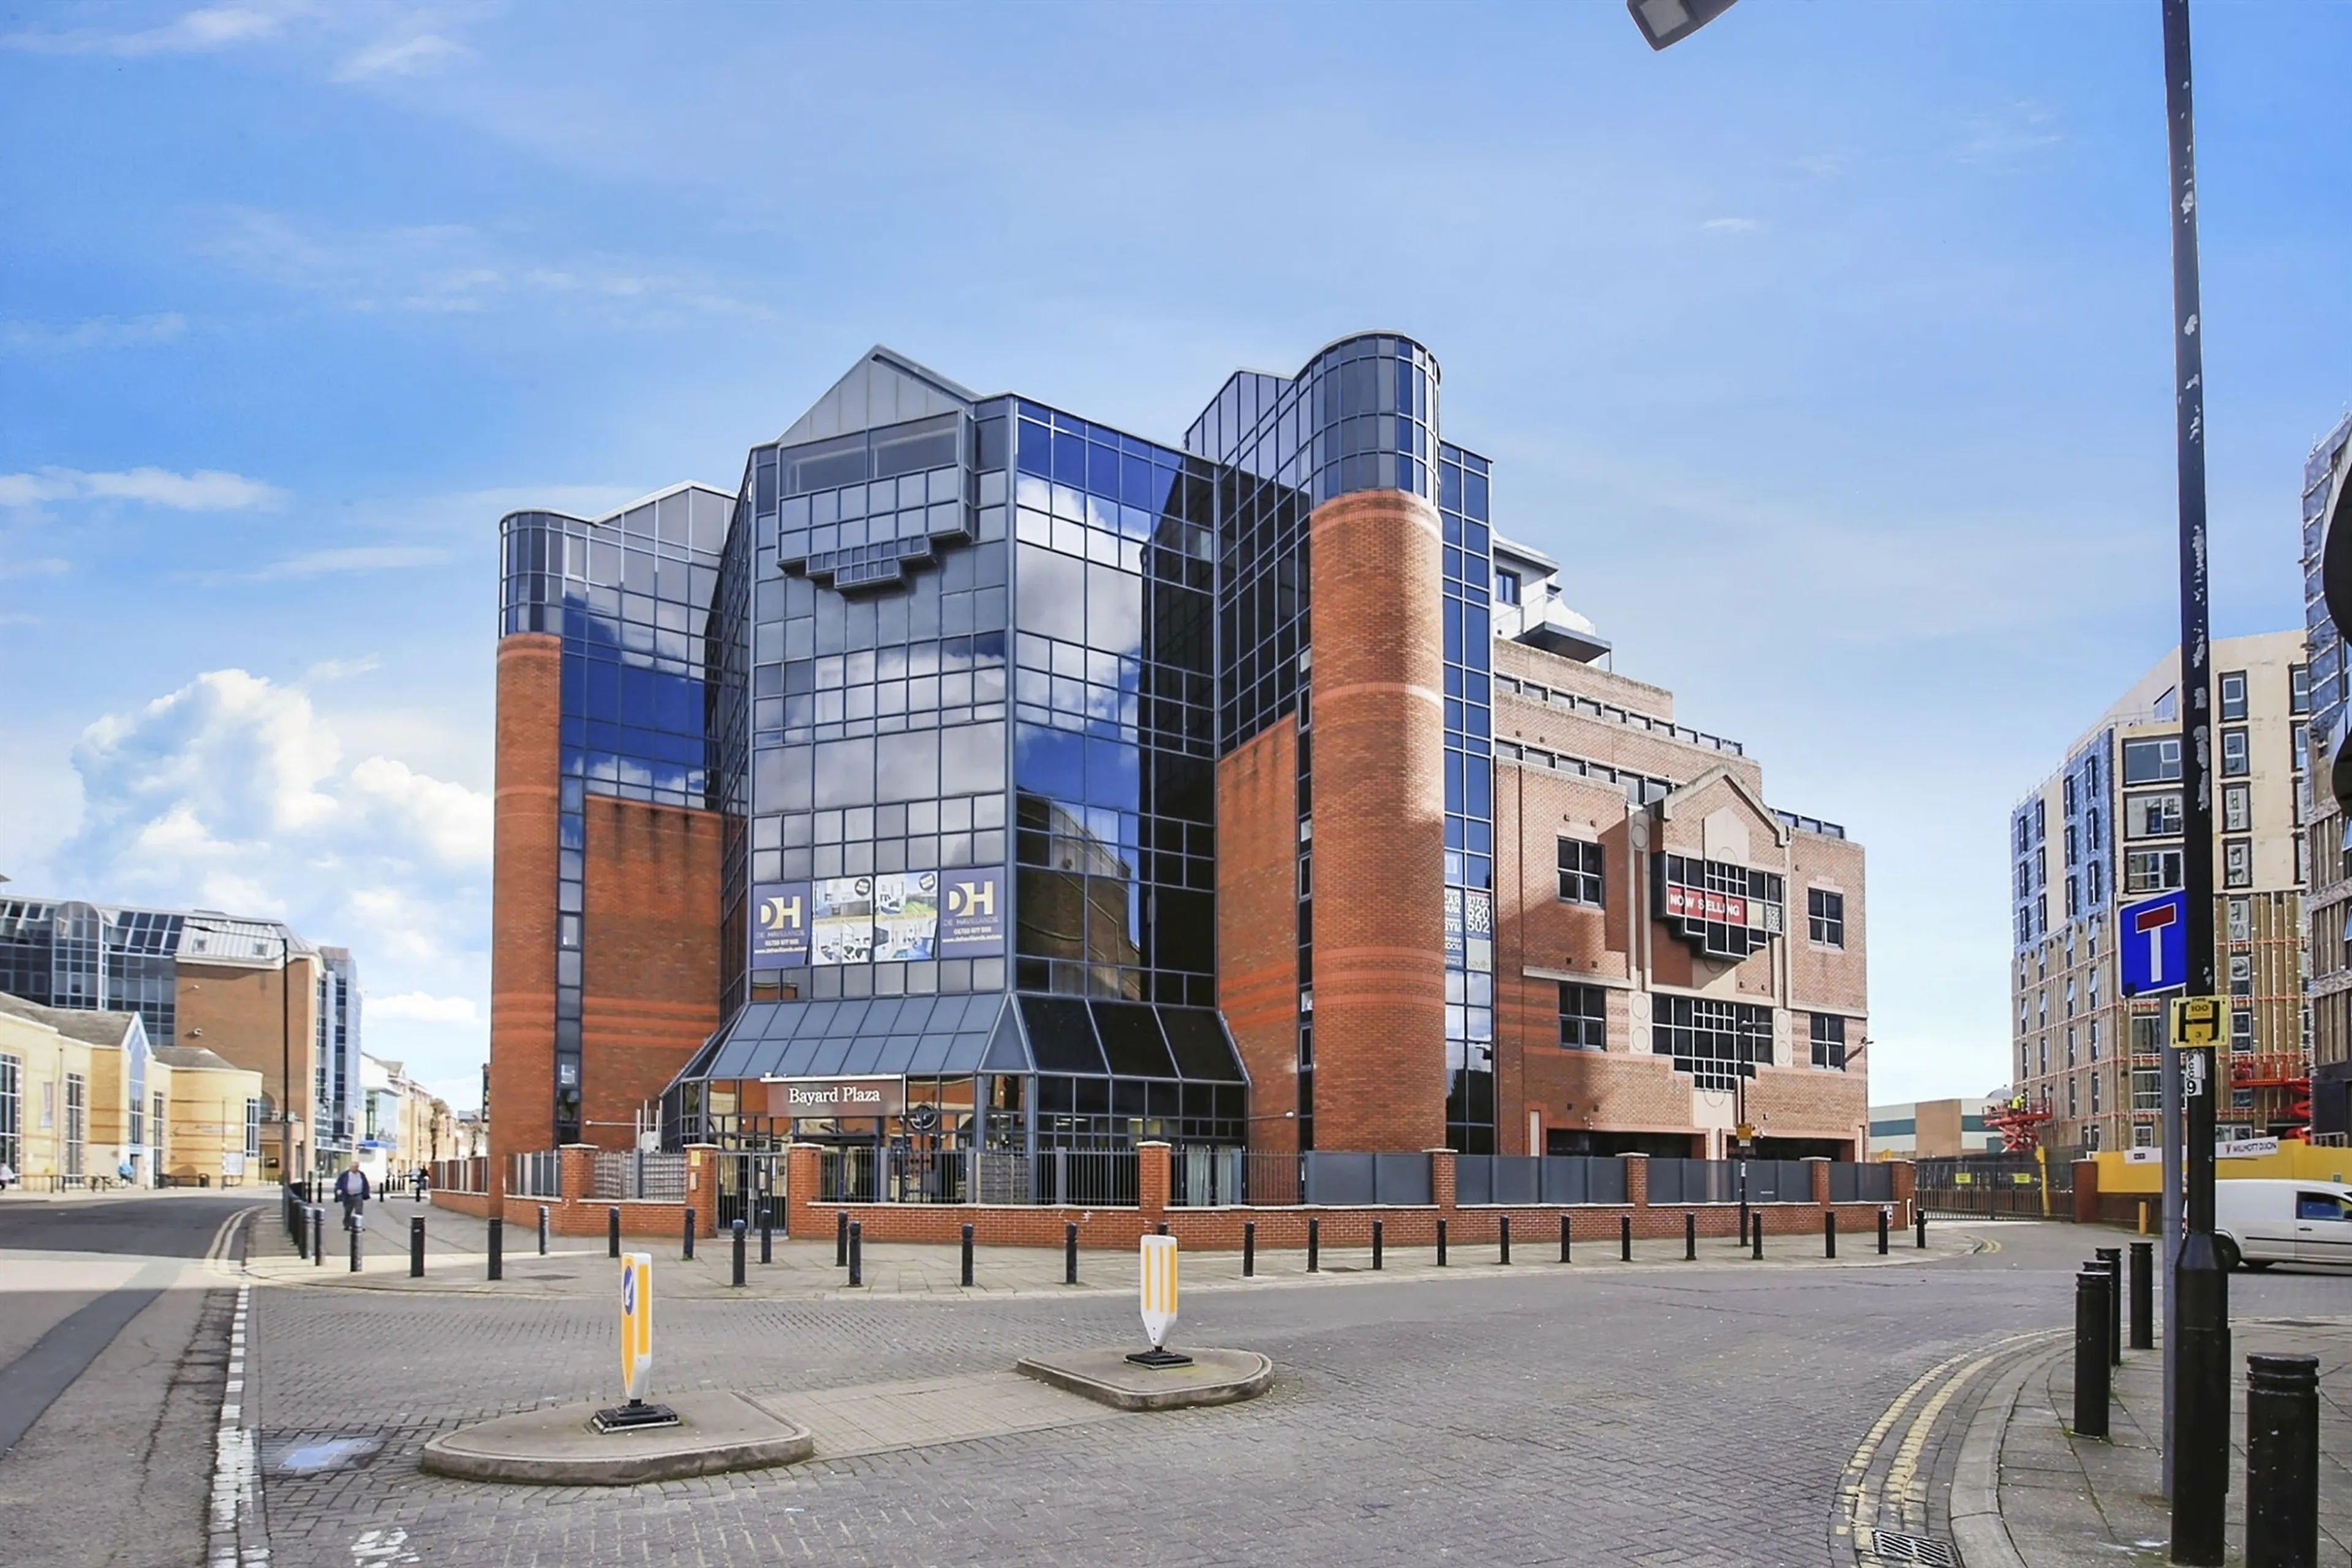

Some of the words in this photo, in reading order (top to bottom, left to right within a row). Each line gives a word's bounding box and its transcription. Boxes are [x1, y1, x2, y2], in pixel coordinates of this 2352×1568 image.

[1468, 905, 1490, 920] 520
[1669, 893, 1695, 908] NOW
[1697, 899, 1740, 916] SELLING
[1467, 918, 1490, 933] 502
[788, 1087, 839, 1106] Bayard
[842, 1086, 881, 1102] Plaza
